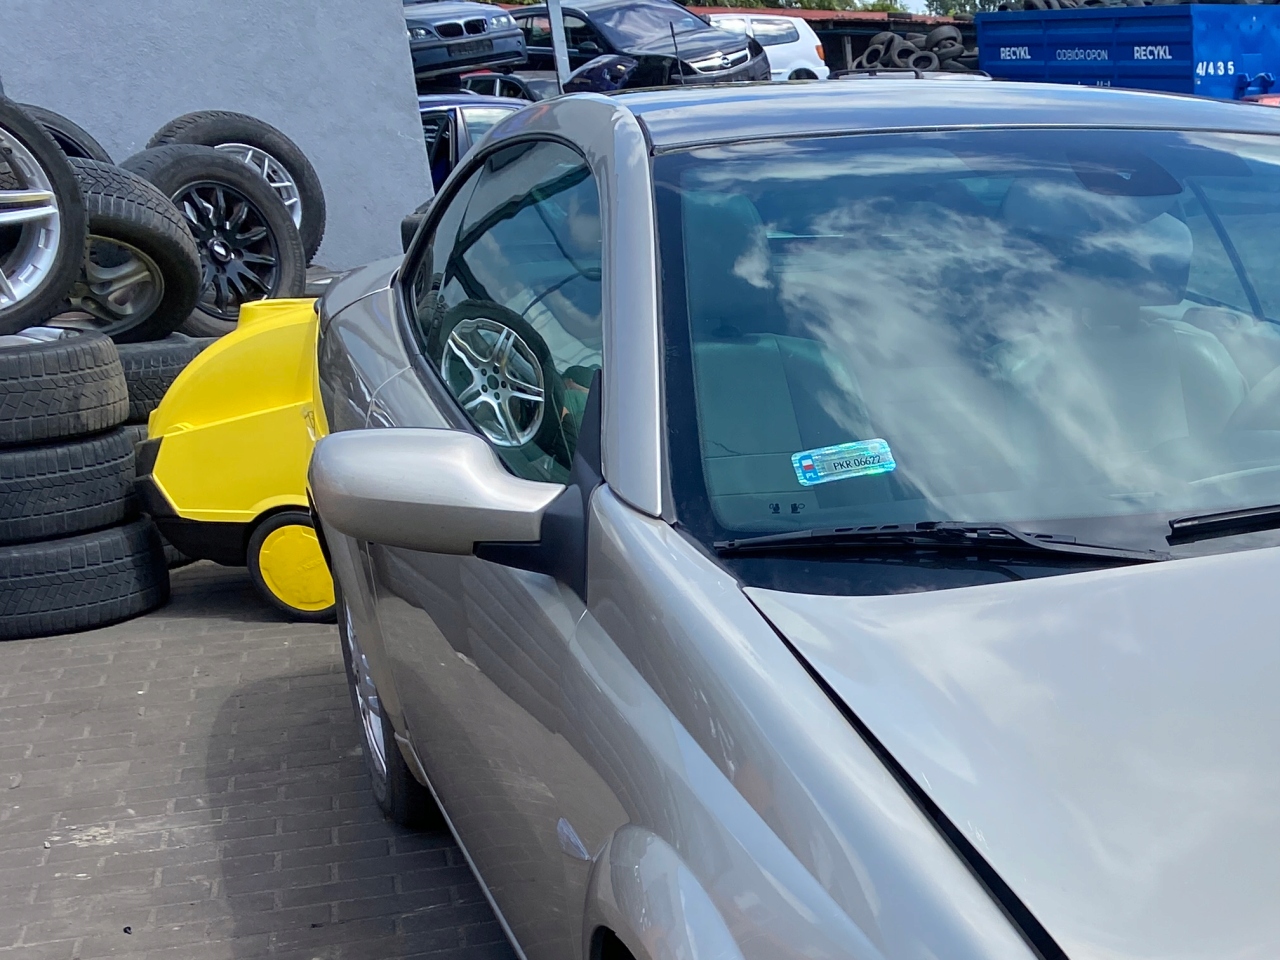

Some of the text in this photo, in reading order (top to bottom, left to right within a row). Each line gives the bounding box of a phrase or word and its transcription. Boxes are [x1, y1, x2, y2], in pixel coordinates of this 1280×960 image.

[1000, 46, 1032, 60] RECYKL
[1056, 47, 1109, 61] ODBIÓR OPON
[1133, 45, 1173, 60] RECYKL
[832, 460, 853, 471] PKR
